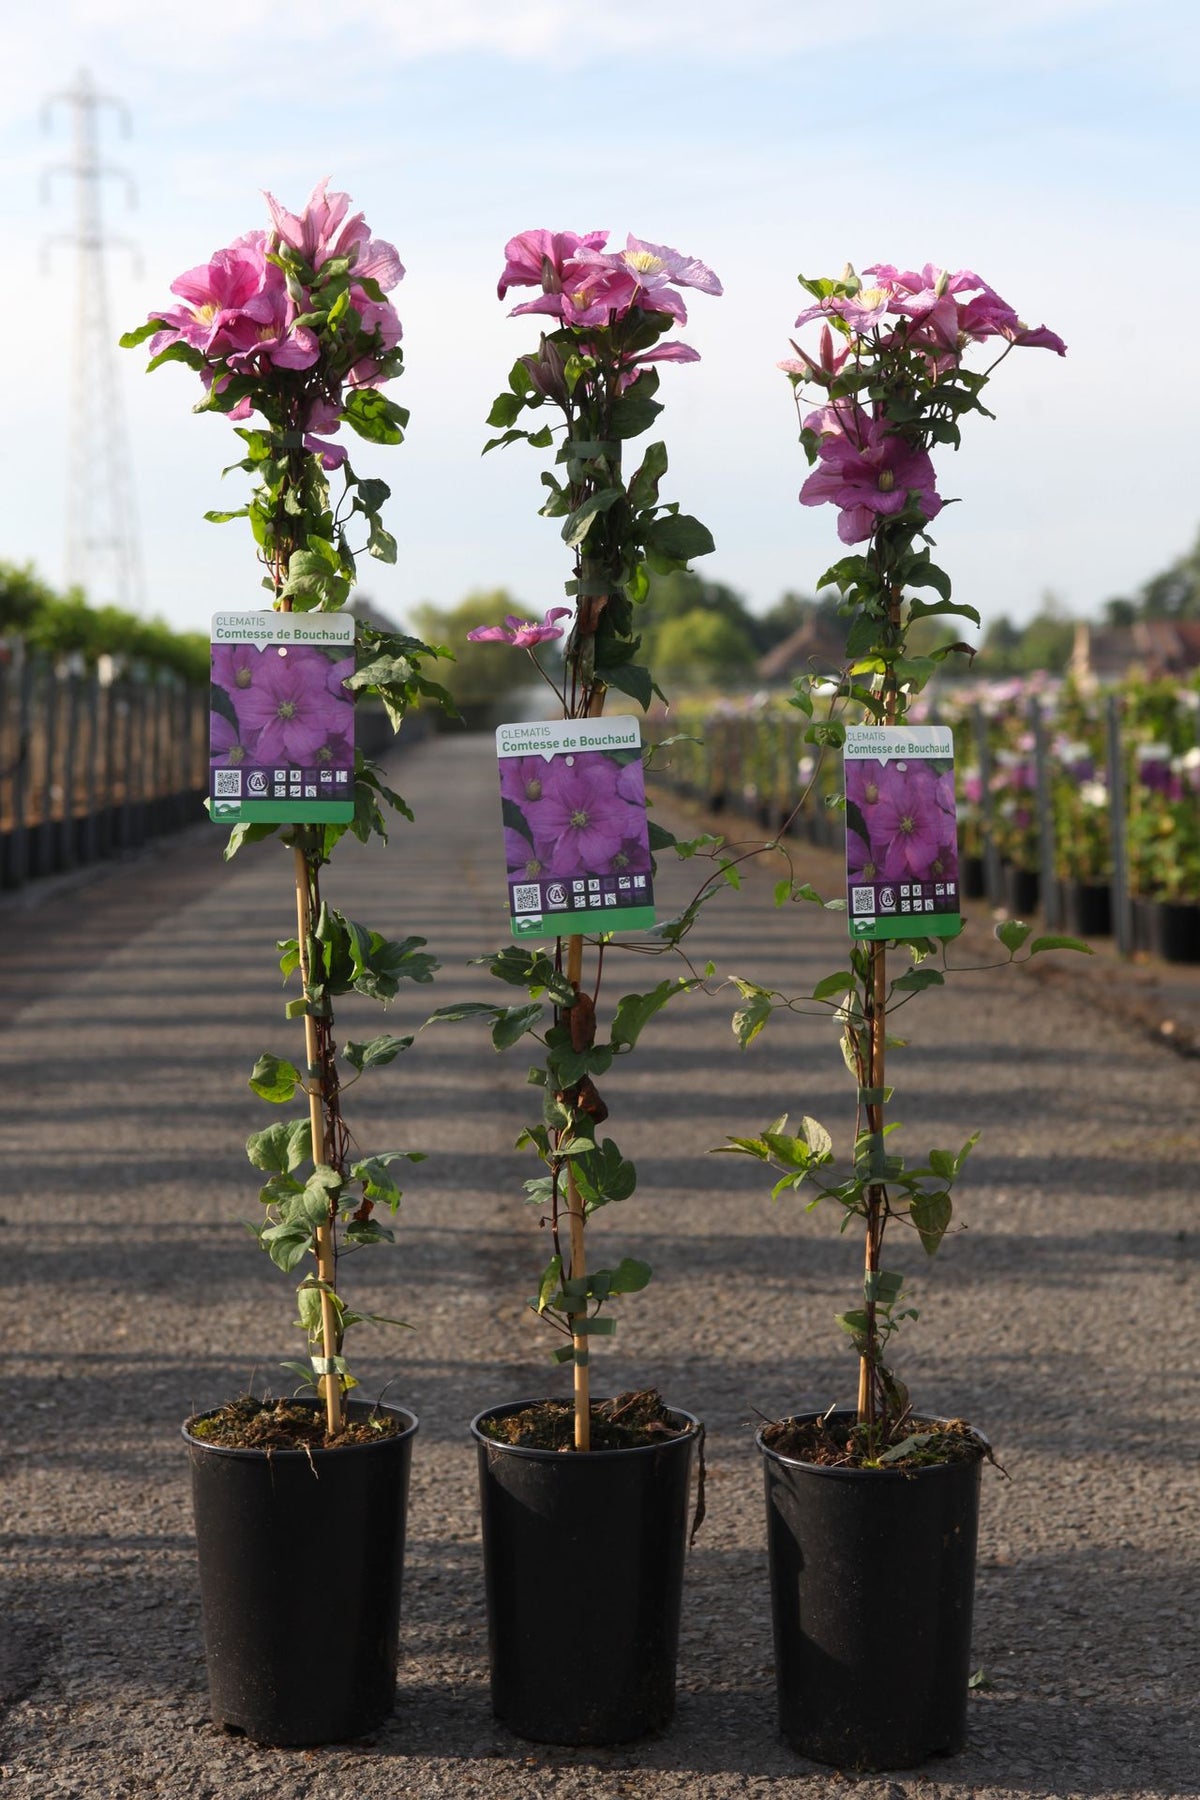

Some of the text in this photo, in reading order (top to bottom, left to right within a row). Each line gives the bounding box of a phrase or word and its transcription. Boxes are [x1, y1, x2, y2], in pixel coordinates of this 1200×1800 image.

[216, 616, 266, 626] CLEMATIS
[216, 628, 350, 640] Comtesse de Bouchaud
[501, 727, 551, 739] CLEMATIS
[847, 731, 886, 741] CLEMATIS
[502, 733, 636, 752] Comtesse de Bouchaud
[847, 743, 950, 754] Comtesse de Bouchaud
